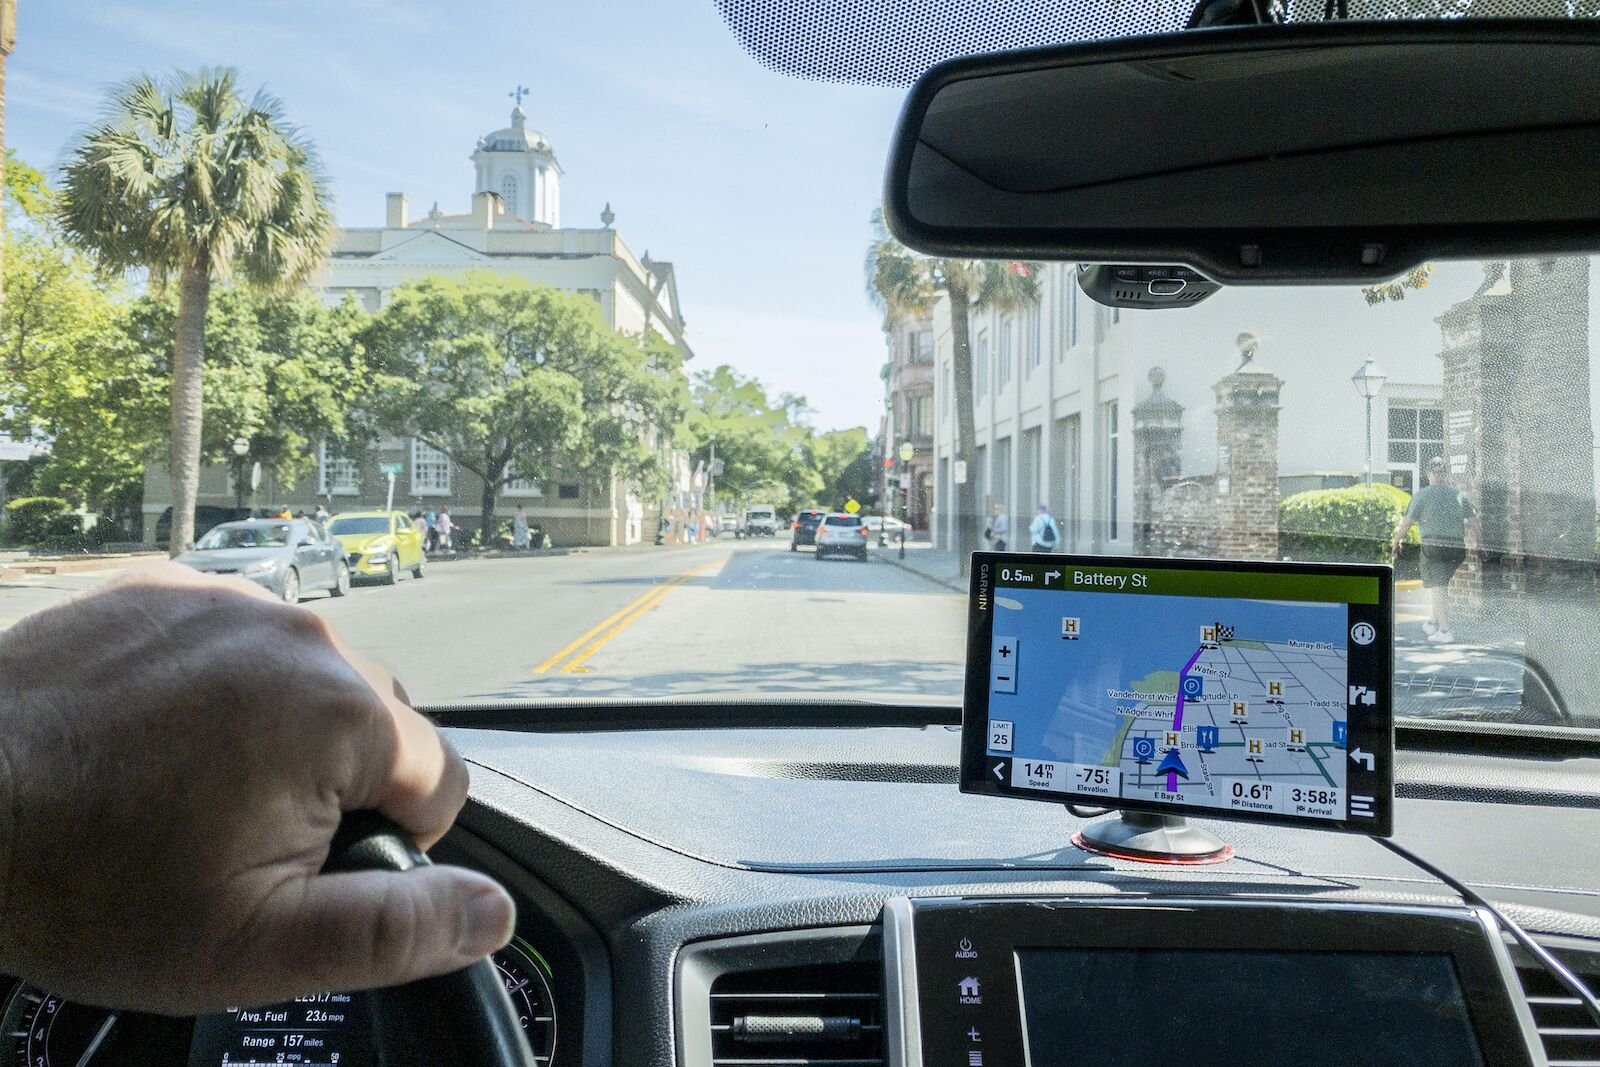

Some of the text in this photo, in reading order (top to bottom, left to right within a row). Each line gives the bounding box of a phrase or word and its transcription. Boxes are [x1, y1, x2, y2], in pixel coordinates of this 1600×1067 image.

[1073, 571, 1148, 589] Battery St
[979, 563, 988, 611] GARMIN
[1289, 640, 1332, 651] Murray Blvd
[1194, 664, 1228, 679] Water St
[1107, 689, 1176, 702] Vanderhorst Whrf
[1201, 692, 1239, 702] gitude Ln
[1309, 700, 1330, 708] Tradd
[1116, 706, 1174, 719] N Adgers Whrf
[1283, 712, 1291, 721] St
[993, 733, 1008, 745] 25
[1181, 741, 1199, 749] Bro
[1025, 763, 1045, 778] 14
[1076, 768, 1104, 784] -75
[1200, 763, 1213, 791] State St
[1028, 780, 1050, 788] Speed
[1077, 785, 1108, 794] Elevation
[1232, 782, 1261, 799] 0.6
[1161, 792, 1175, 802] Bay
[1292, 788, 1328, 805] 3:58
[1241, 800, 1273, 810] Distance
[1307, 807, 1333, 816] Arrival
[955, 951, 978, 959] AUDIO
[331, 994, 351, 1002] miles
[959, 997, 983, 1005] HOME
[46, 1000, 56, 1014] 5
[240, 1010, 345, 1022] Avg. Fuel 23.6 mpg
[35, 1028, 44, 1041] 4
[242, 1035, 324, 1047] Range 157 miles
[275, 1052, 302, 1061] 25 mpg
[330, 1052, 340, 1060] 50
